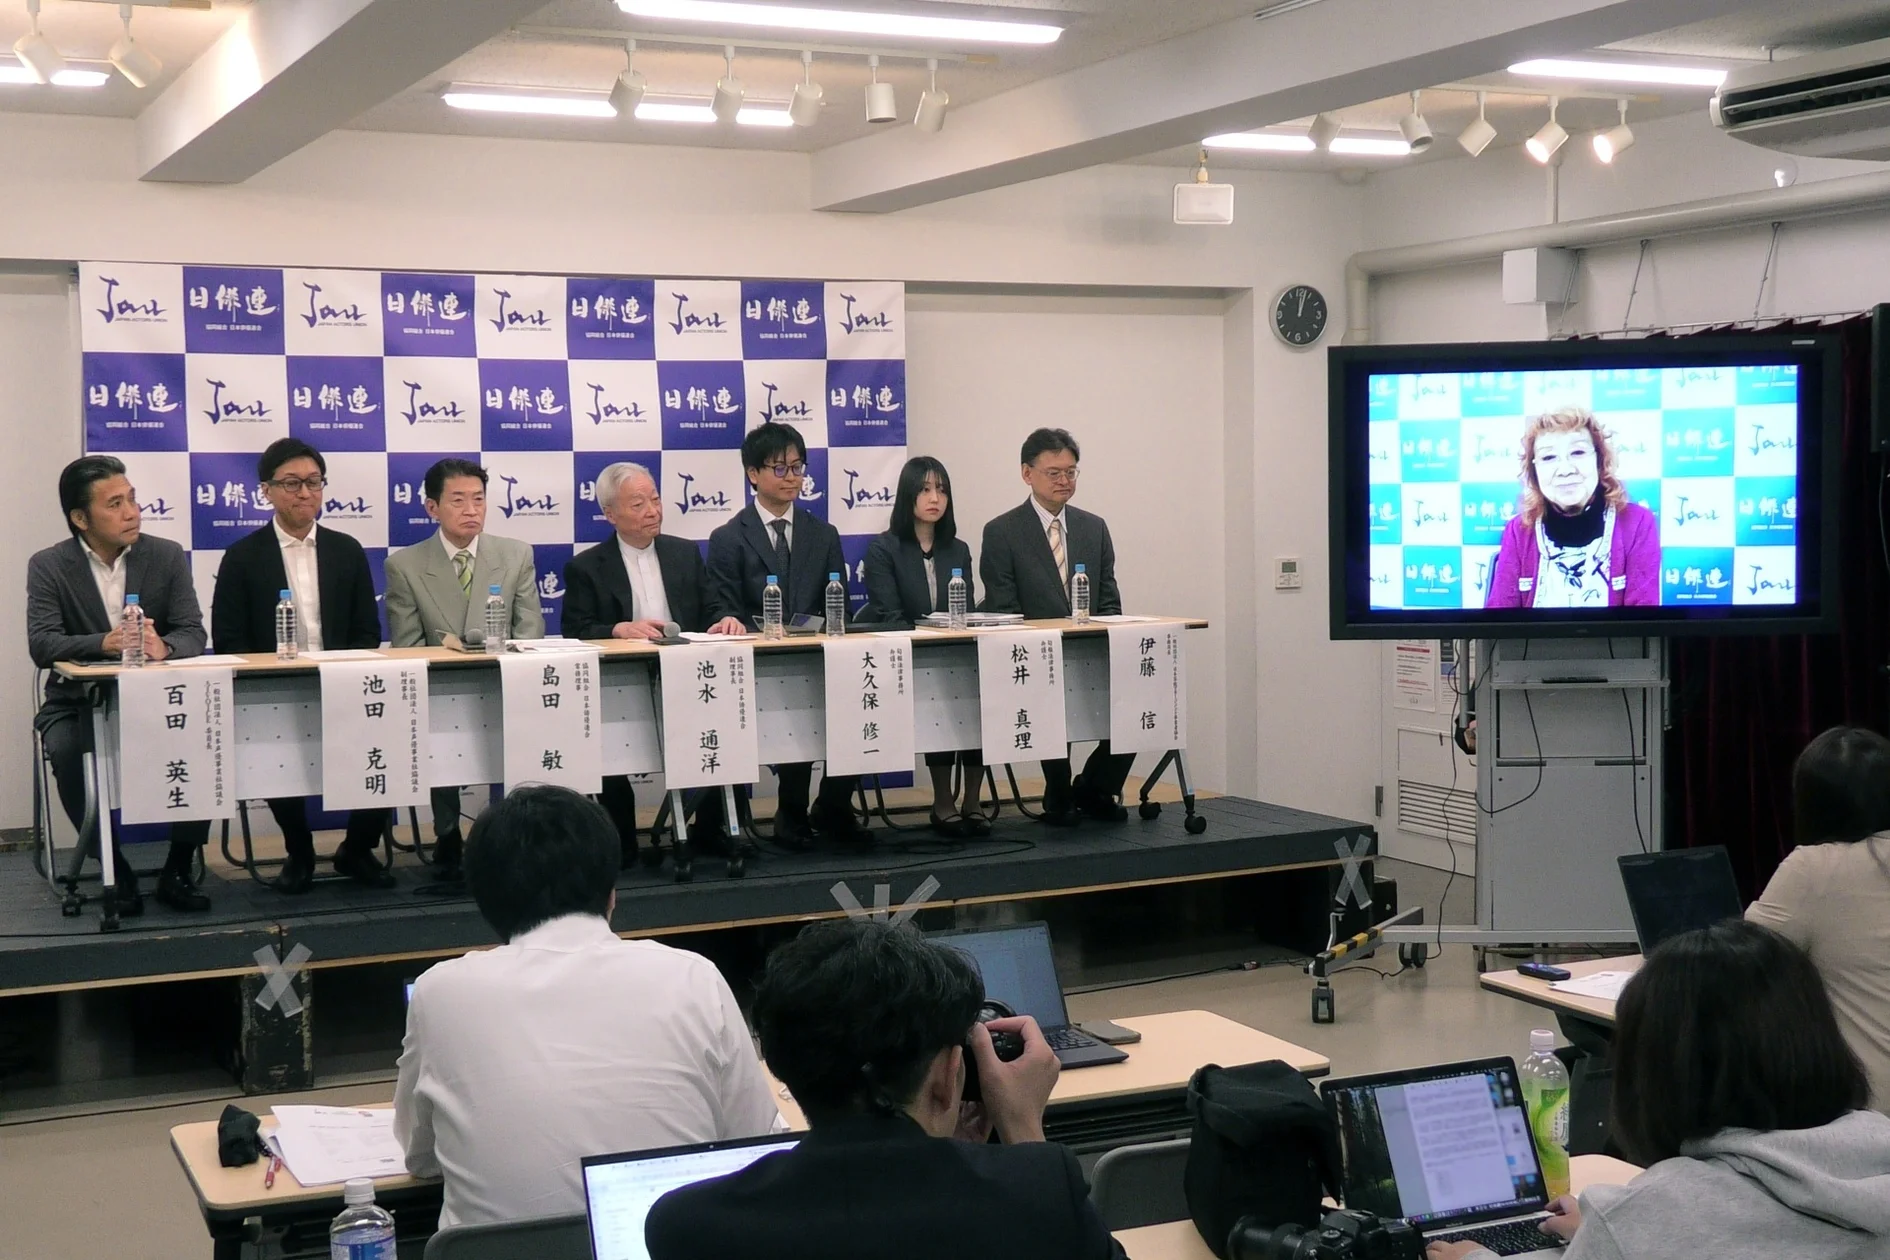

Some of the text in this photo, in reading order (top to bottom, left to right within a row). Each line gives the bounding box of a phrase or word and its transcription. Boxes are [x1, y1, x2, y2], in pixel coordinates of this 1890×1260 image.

[363, 674, 387, 795] 池田 克明
[541, 664, 563, 771] 島田 敏
[697, 660, 720, 774] 池水 通洋
[861, 651, 880, 754] 大久保 修一
[1011, 644, 1032, 750] 松井 真理
[1139, 637, 1157, 730] 伊藤 信
[163, 684, 190, 809] 百田 英生
